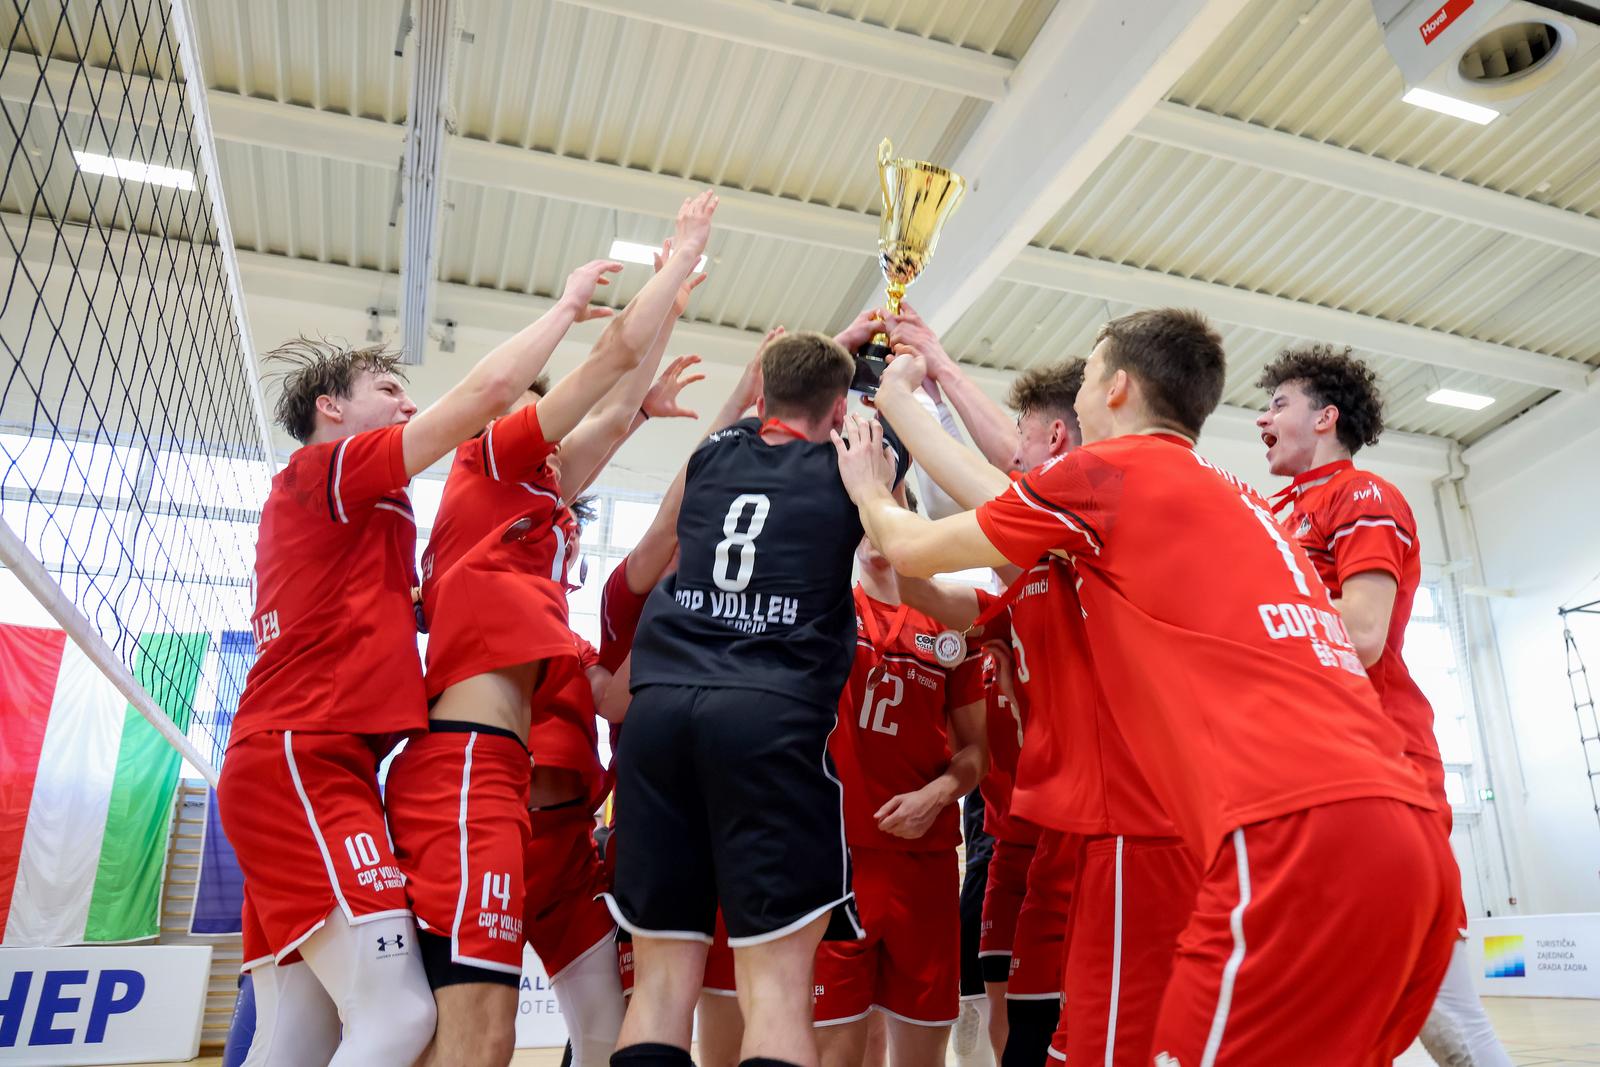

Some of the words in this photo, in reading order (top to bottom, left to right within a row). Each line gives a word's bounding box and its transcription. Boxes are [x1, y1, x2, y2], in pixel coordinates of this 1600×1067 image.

[1422, 9, 1448, 37] Hoval
[1353, 489, 1372, 502] SVF
[712, 493, 770, 592] 8
[709, 591, 799, 625] VOLLEY
[1258, 603, 1318, 640] COP
[859, 666, 904, 736] 12
[344, 832, 380, 870] 10
[358, 868, 378, 886] COP
[481, 871, 511, 911] 14
[479, 912, 499, 928] COP
[1536, 938, 1576, 948] TURISTIČKA
[1537, 951, 1575, 961] ZAJEDNICA
[1537, 963, 1562, 971] GRADA
[1563, 964, 1588, 972] ZADRA
[0, 969, 146, 1047] HEP
